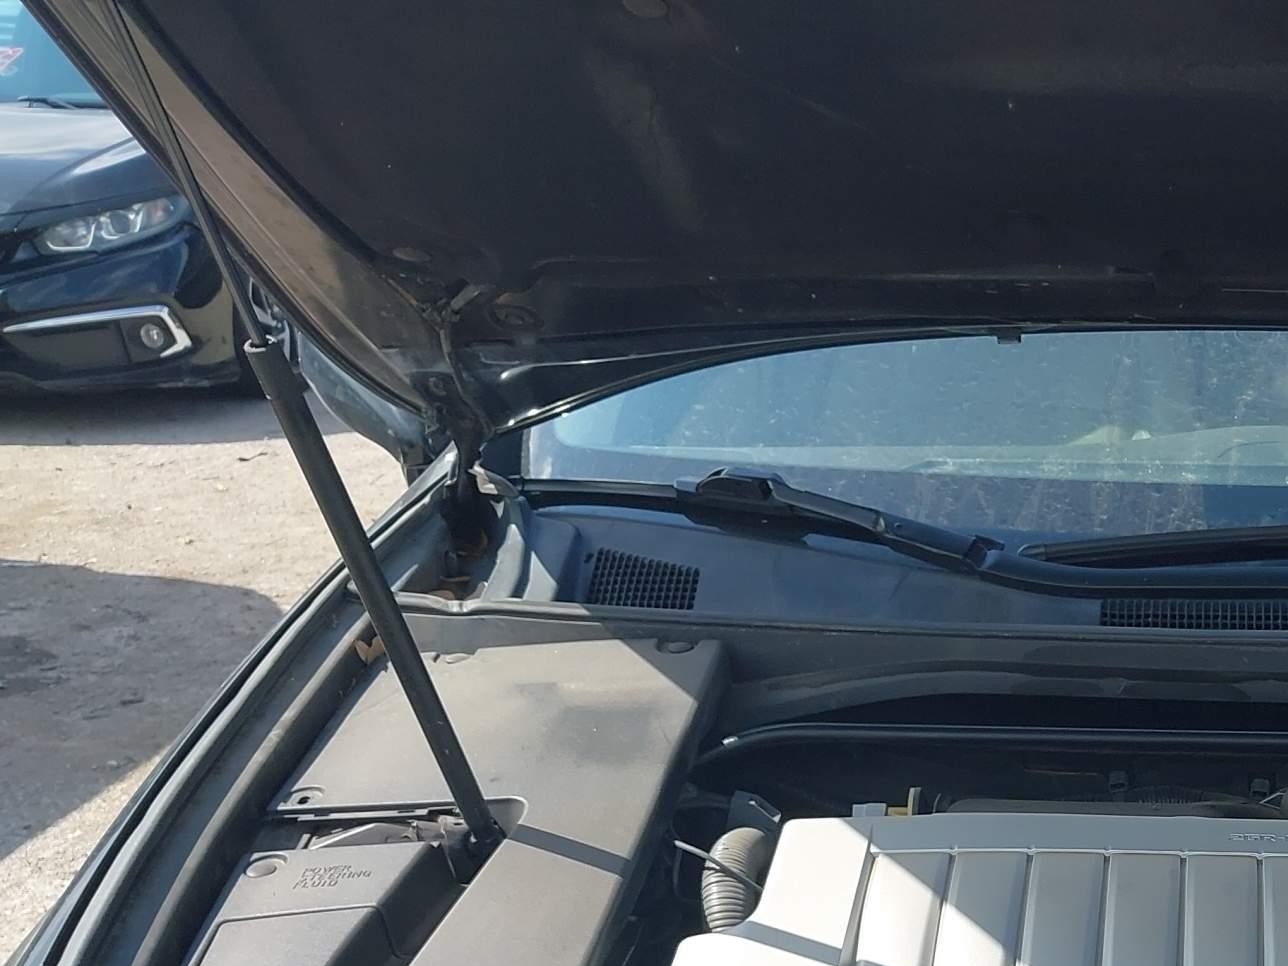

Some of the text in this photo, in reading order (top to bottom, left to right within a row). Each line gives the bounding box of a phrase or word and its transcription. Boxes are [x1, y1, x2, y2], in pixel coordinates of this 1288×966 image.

[298, 870, 373, 881] STEERING
[302, 864, 352, 877] POWER
[292, 879, 339, 890] FLUID
